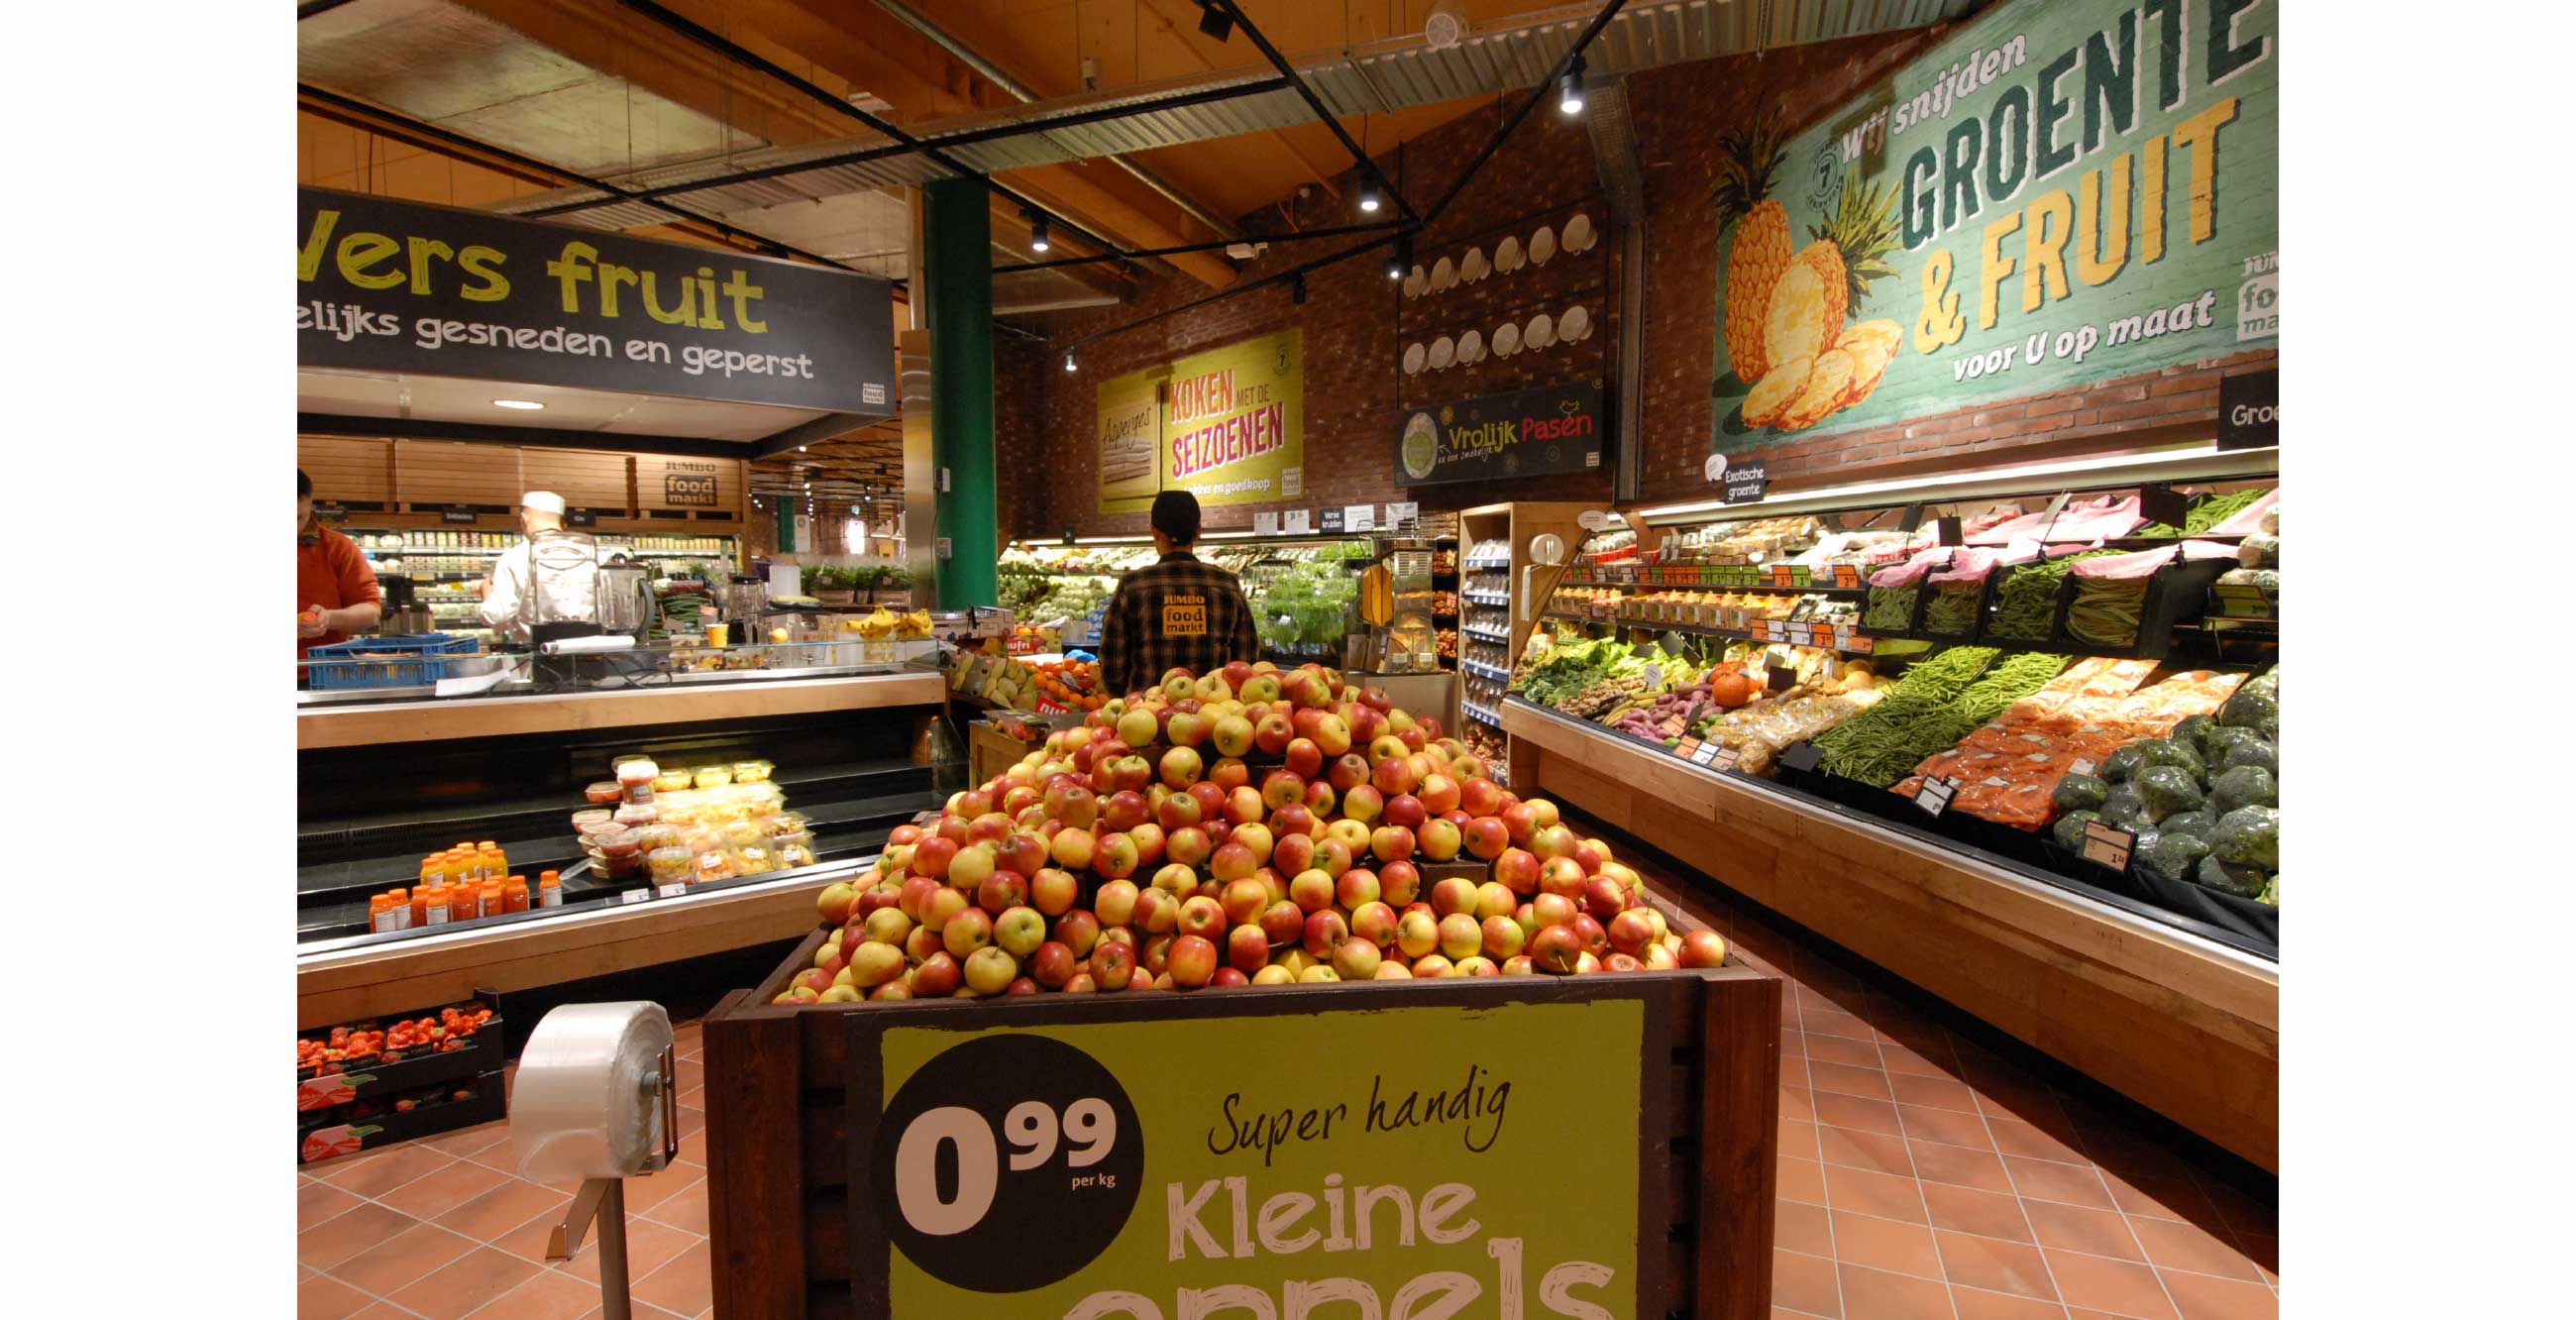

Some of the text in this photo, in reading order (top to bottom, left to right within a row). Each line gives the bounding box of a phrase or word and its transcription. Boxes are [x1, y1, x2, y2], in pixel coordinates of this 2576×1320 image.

[1841, 33, 2027, 165] Wij snijden
[1902, 0, 2271, 251] GROENTE
[1914, 95, 2241, 355] & FRUIT
[546, 241, 768, 334] fruit
[415, 317, 612, 358] gesneden
[625, 338, 671, 364] en
[683, 344, 813, 378] geperst
[1953, 288, 2218, 381] voor U op maat
[1170, 369, 1270, 424] KOKEN MET DE
[1103, 406, 1151, 450] Asperges
[1172, 401, 1284, 479] SEIZOENEN
[1449, 414, 1591, 453] Vrolijk Pasen
[668, 476, 713, 493] food
[1225, 478, 1270, 495] goedkoop
[1726, 468, 1764, 483] Exotische
[1729, 484, 1761, 500] groente
[668, 495, 713, 504] markt
[1163, 595, 1206, 605] JUMBO
[1166, 608, 1203, 621] food
[1166, 622, 1203, 632] markt
[1208, 1064, 1511, 1167] Super handig
[1072, 1173, 1116, 1190] per kg
[1167, 1173, 1481, 1262] Kleine
